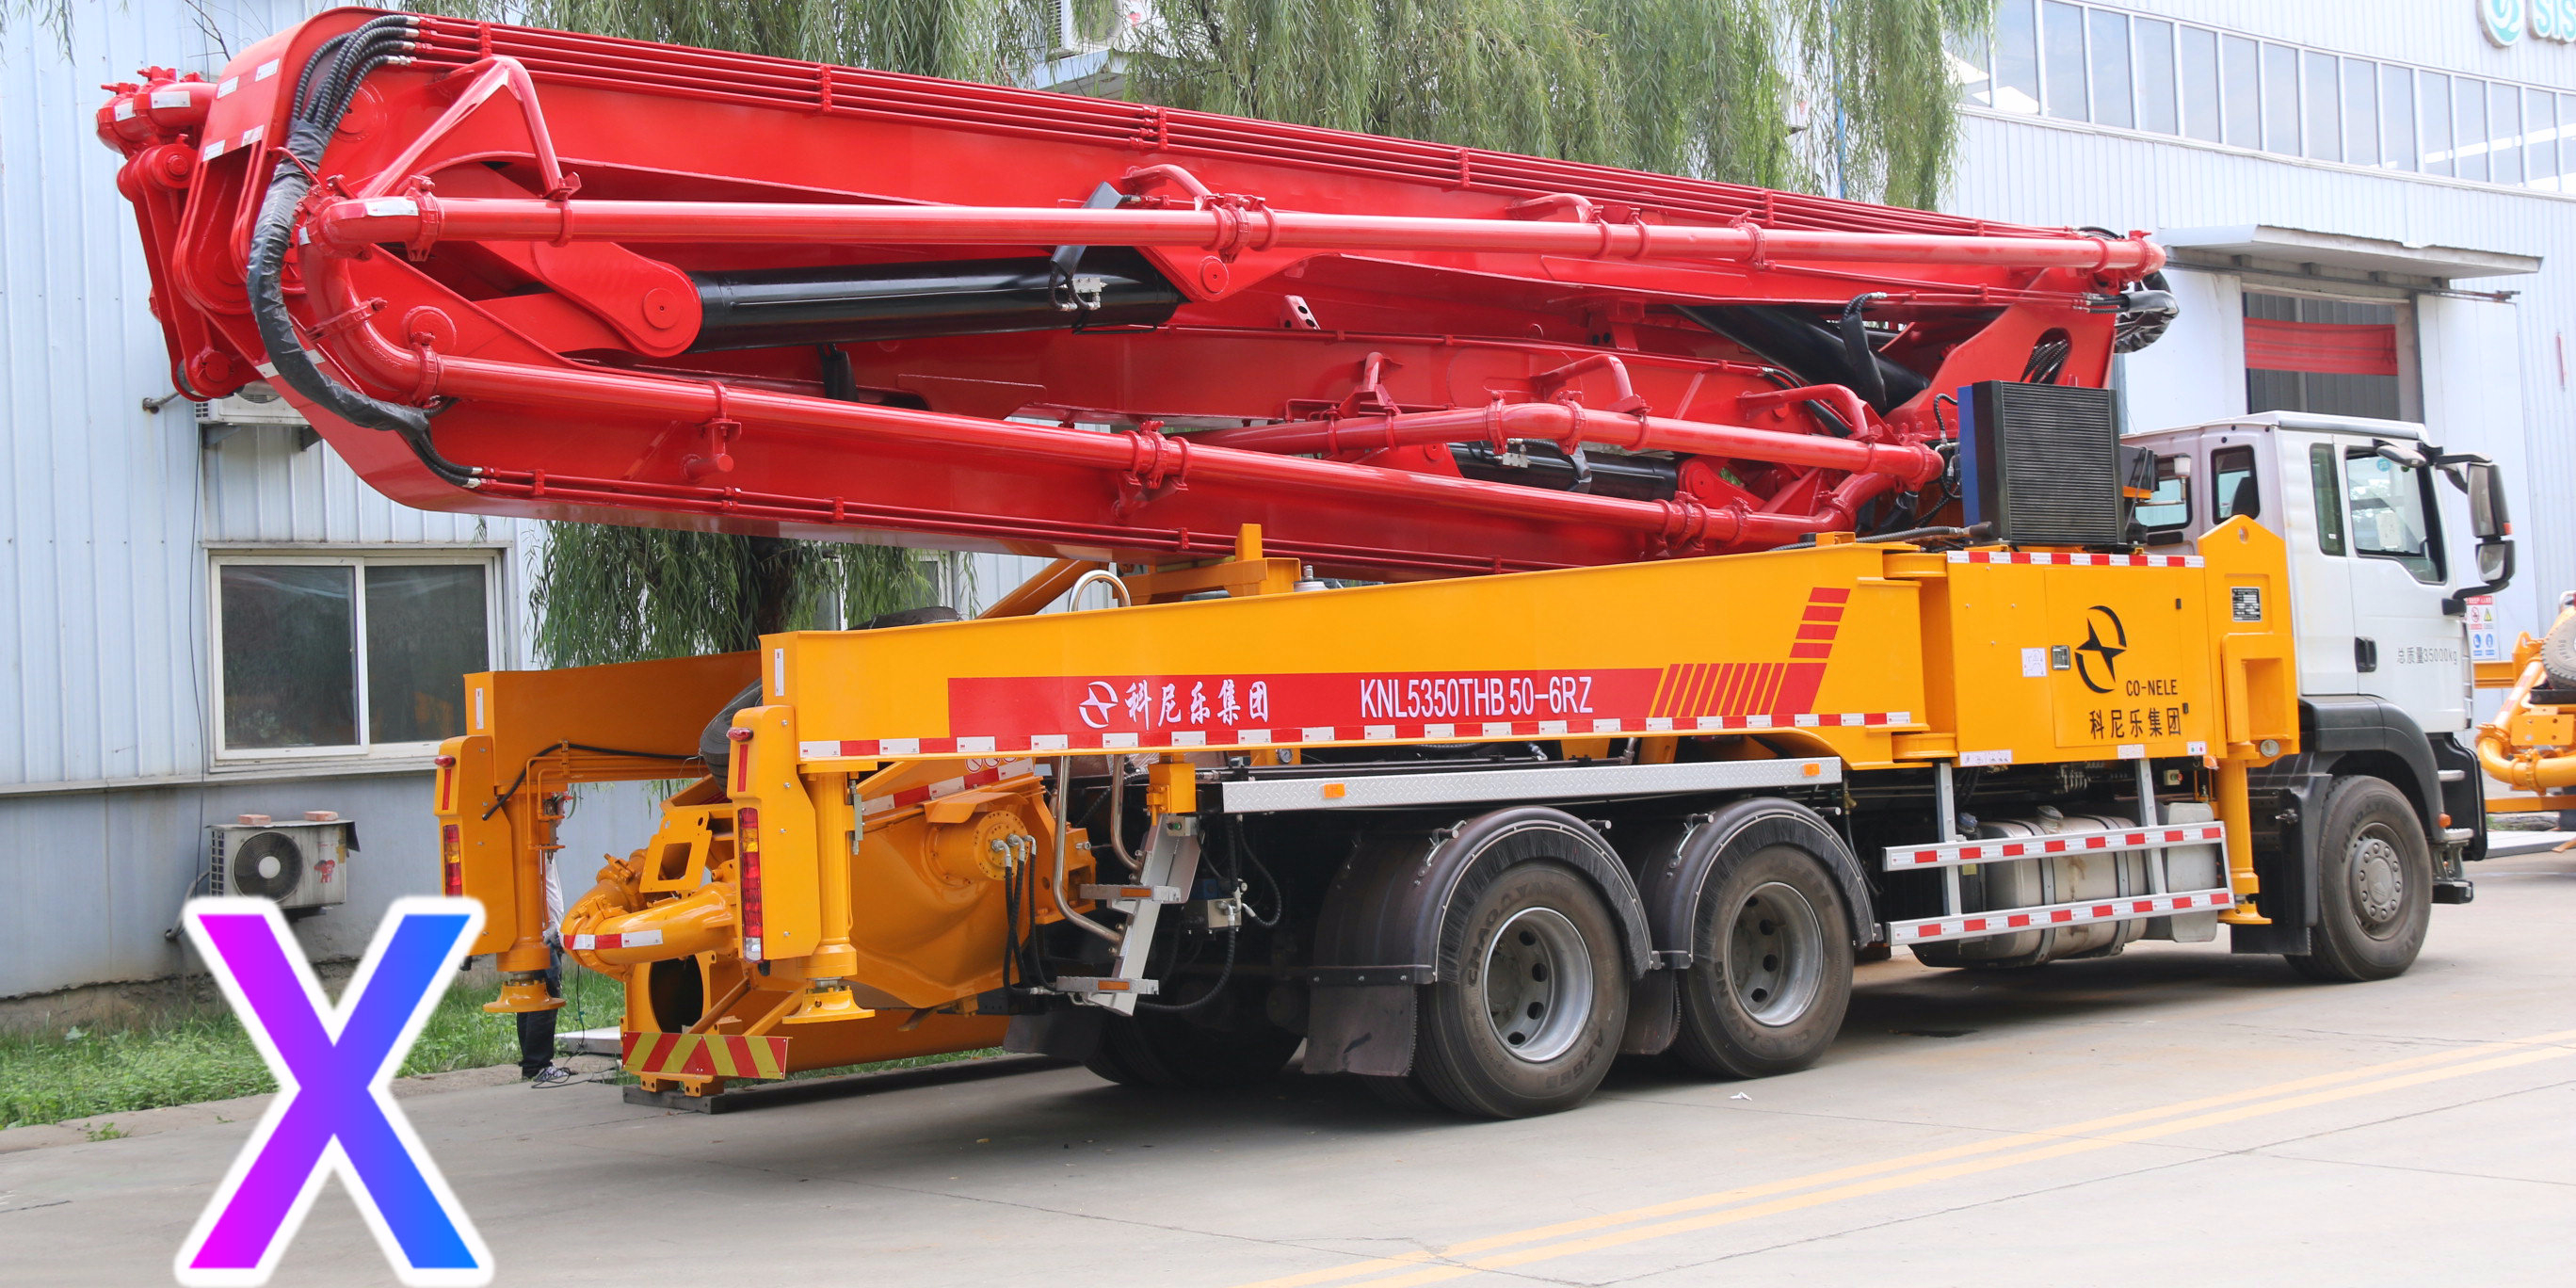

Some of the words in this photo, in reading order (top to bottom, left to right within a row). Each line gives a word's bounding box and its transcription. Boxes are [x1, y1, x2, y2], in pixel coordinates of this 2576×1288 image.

[2397, 646, 2456, 665] 总质量35000kg
[1360, 677, 1505, 718] KNL5350THB
[1508, 676, 1593, 716] 50-6RZ
[2126, 679, 2178, 696] CO-NELE
[1124, 679, 1268, 731] 科尼乐集团
[2089, 707, 2182, 739] 科尼乐集团
